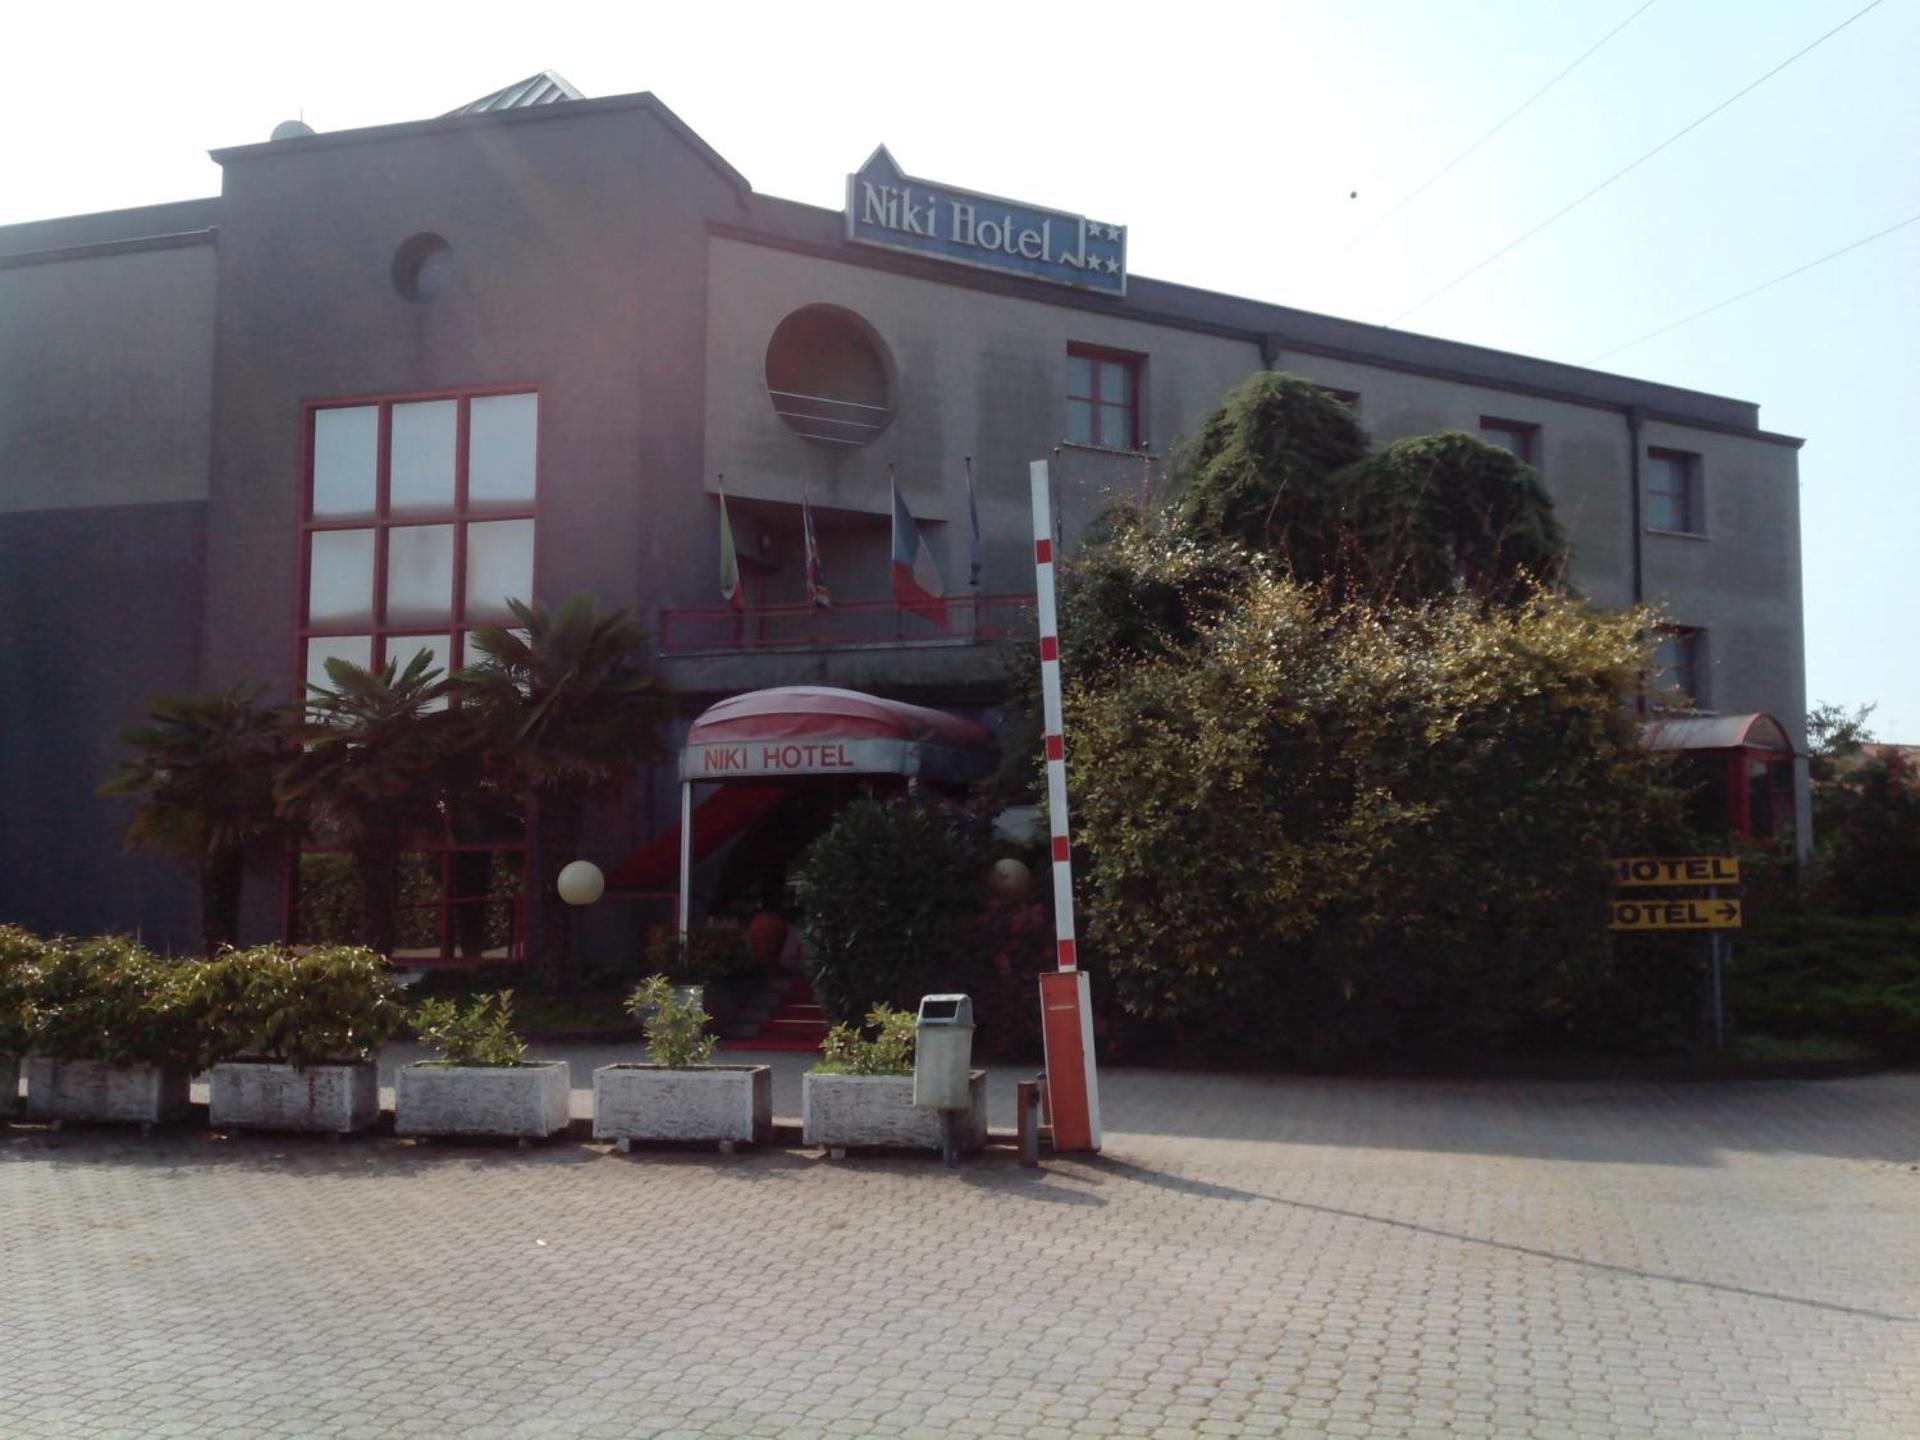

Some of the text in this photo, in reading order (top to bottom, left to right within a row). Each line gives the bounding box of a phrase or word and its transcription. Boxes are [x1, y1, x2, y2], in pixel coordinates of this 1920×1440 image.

[861, 181, 1050, 262] Niki Hotel
[704, 745, 854, 770] NIKI HOTEL
[1610, 903, 1709, 924] OTEL
